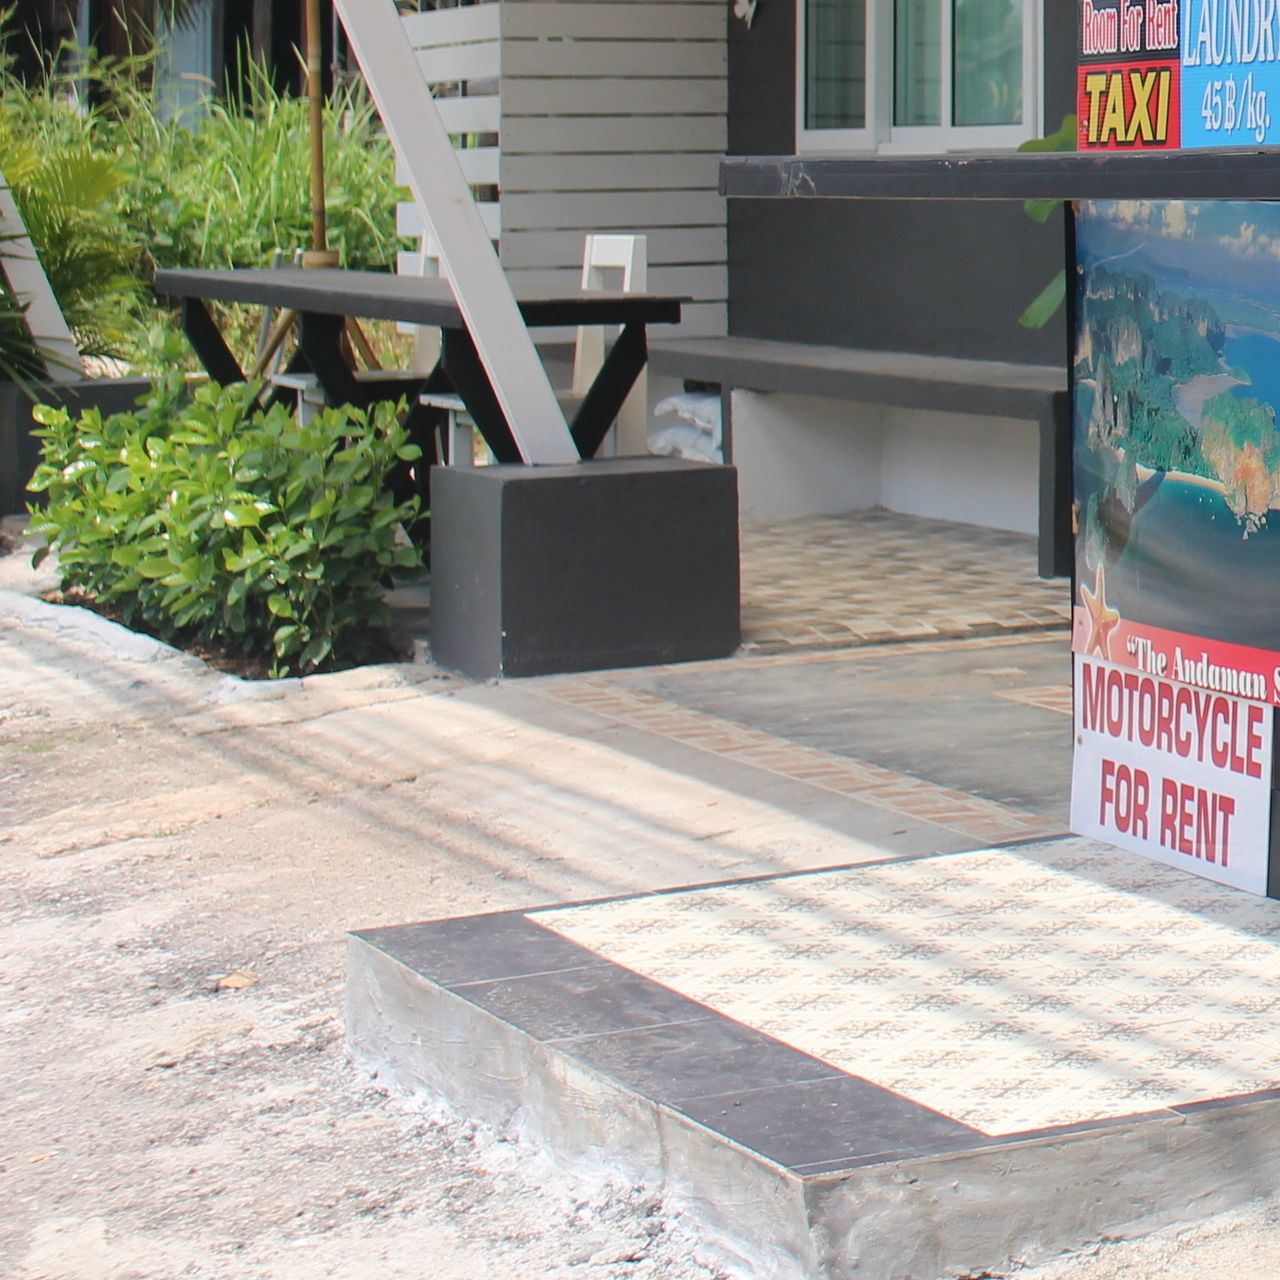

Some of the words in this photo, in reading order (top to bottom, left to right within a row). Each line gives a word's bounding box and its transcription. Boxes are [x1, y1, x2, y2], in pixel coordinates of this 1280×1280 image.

[1085, 68, 1171, 146] TAXI
[1171, 646, 1268, 701] Andaman
[1082, 662, 1264, 780] MOTORCYCLE
[1098, 758, 1151, 842] FOR
[1159, 776, 1236, 868] RENT
